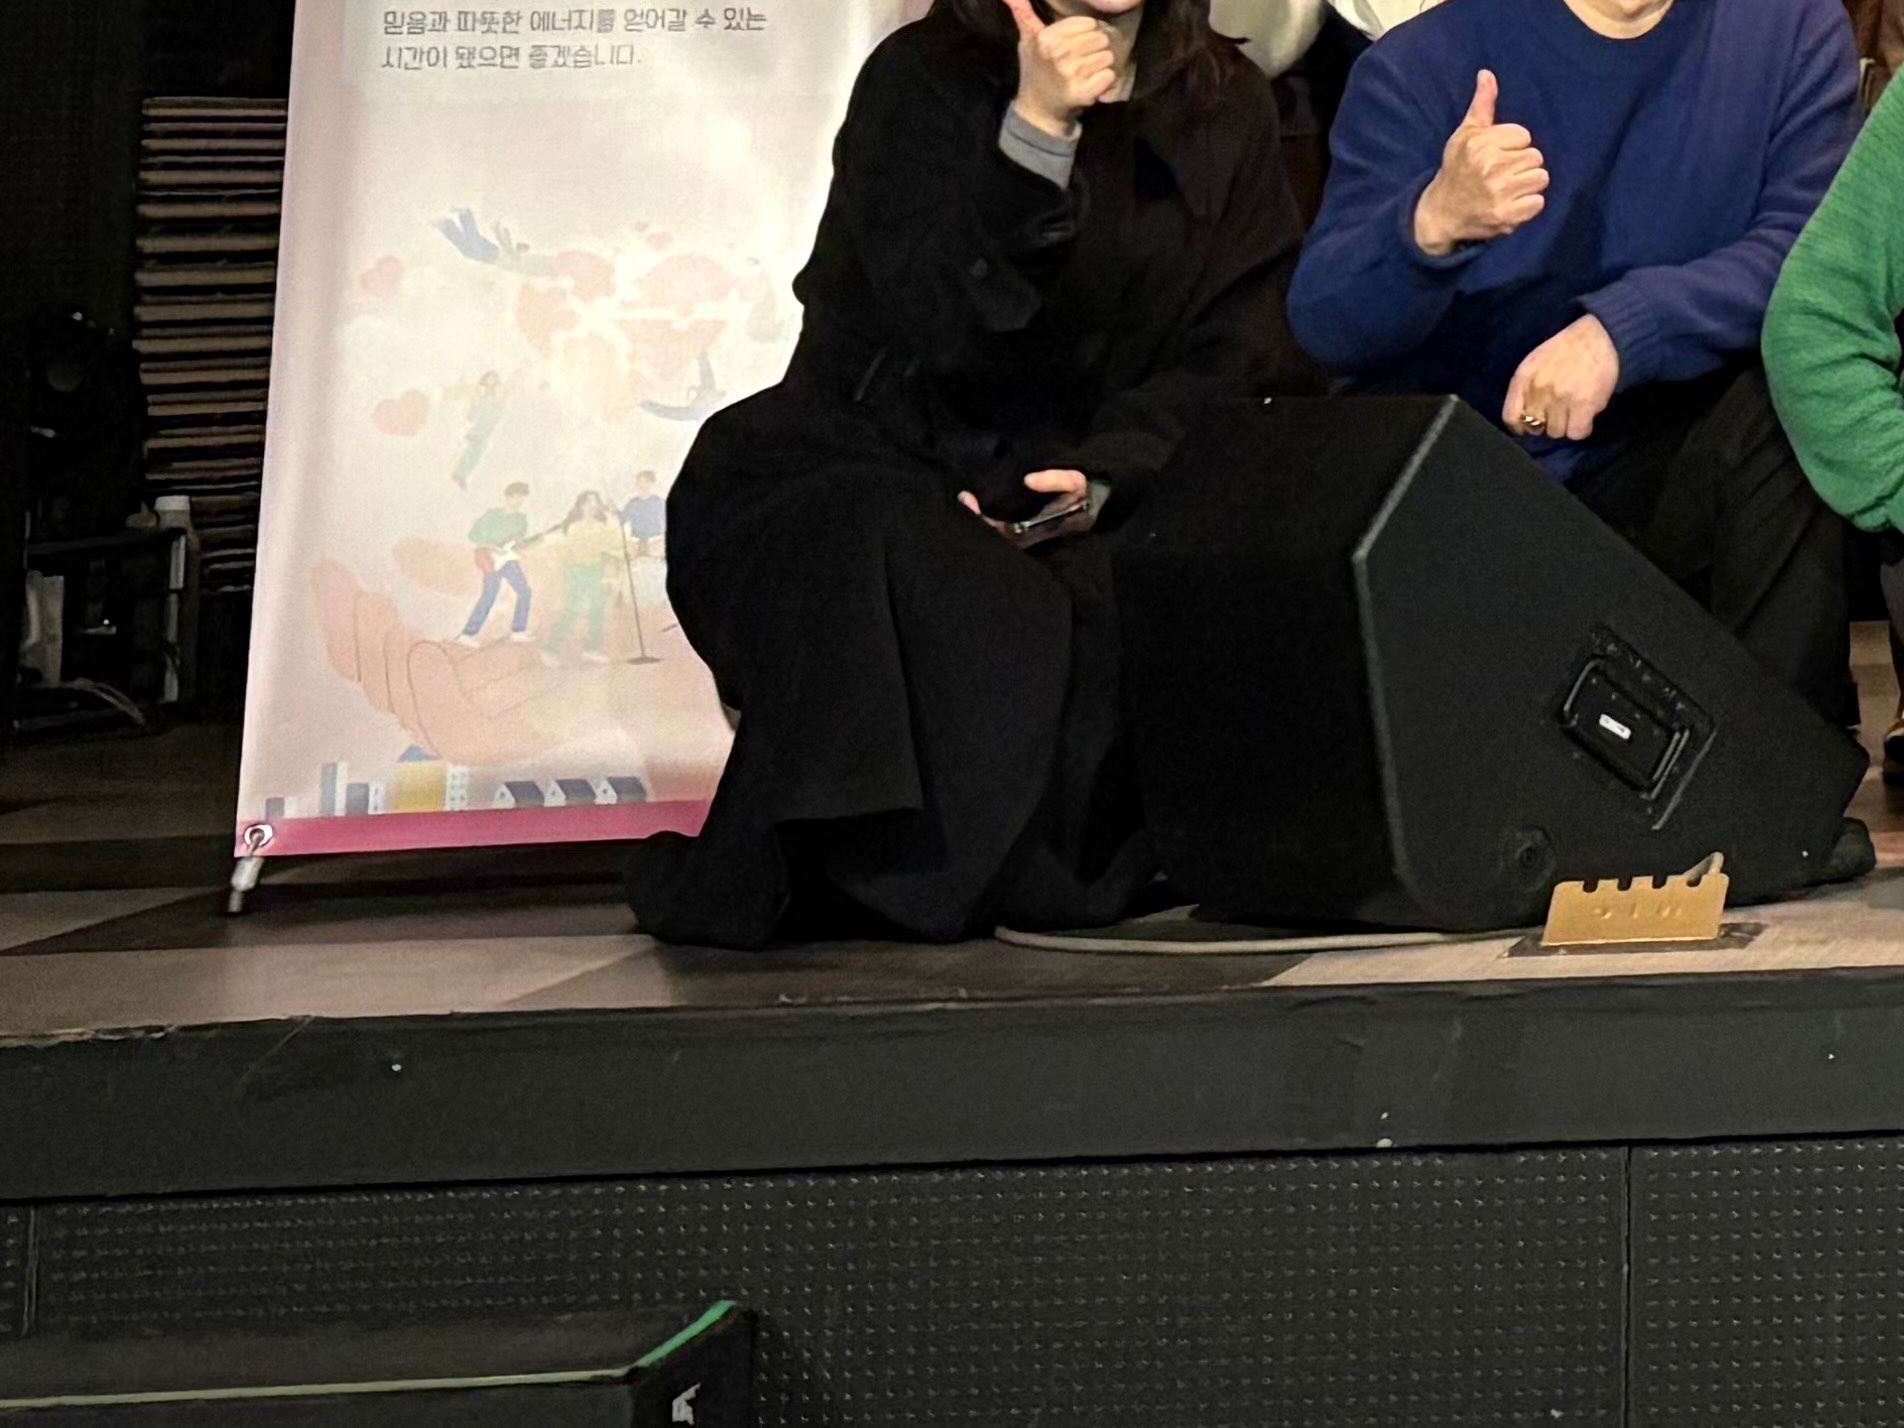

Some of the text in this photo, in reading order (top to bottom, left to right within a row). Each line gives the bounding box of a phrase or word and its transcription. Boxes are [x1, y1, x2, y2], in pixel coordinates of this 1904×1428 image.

[383, 6, 768, 35] 믿음과 따뜻한 에너지를 얻어갈 수 있는
[380, 43, 642, 70] 시간이 됐으면 좋겠습니다.
